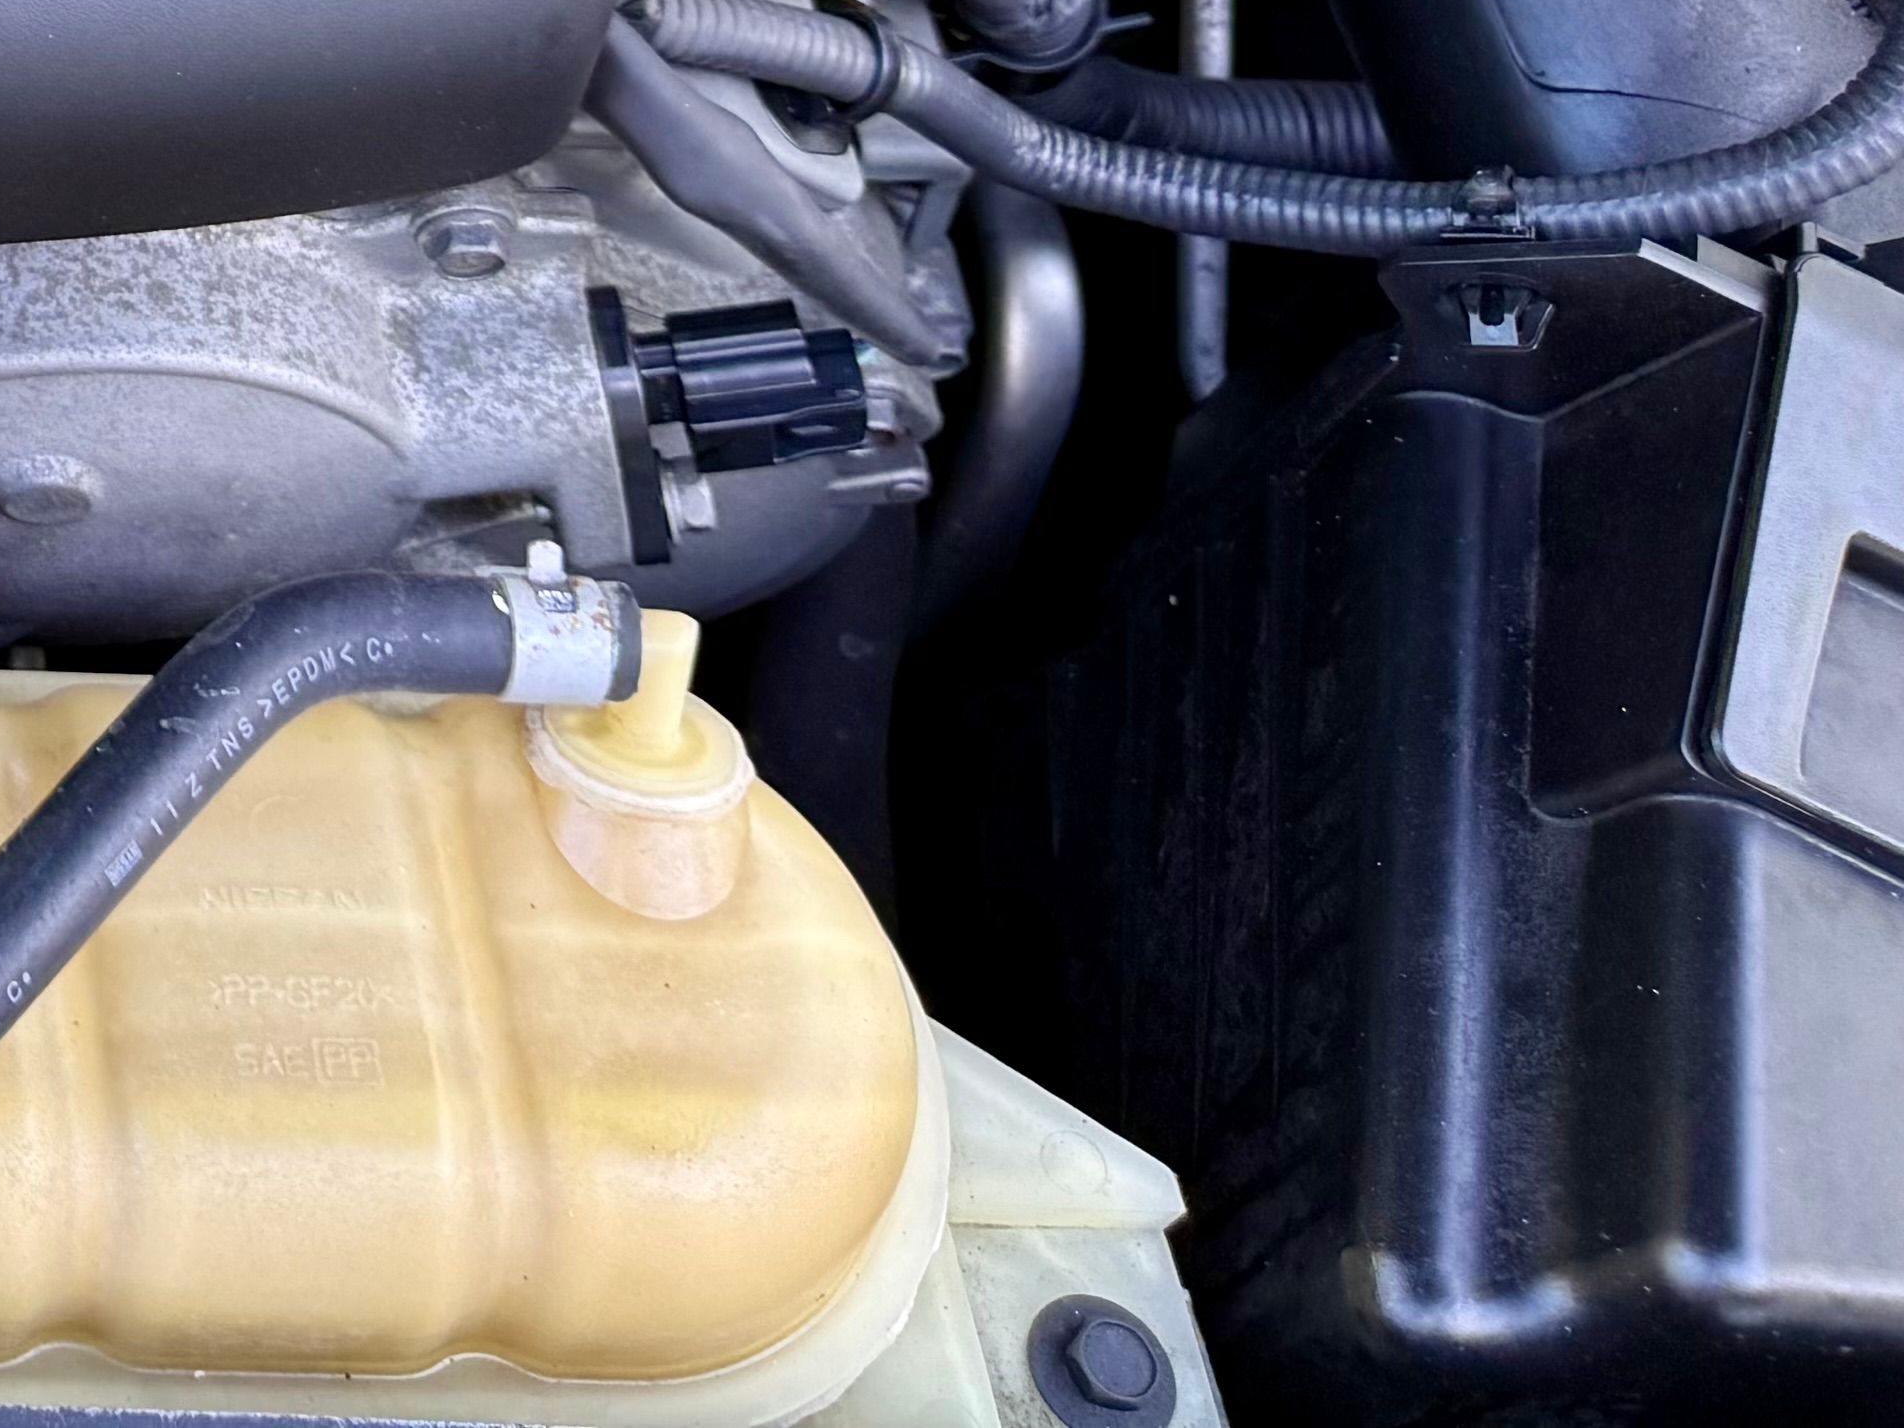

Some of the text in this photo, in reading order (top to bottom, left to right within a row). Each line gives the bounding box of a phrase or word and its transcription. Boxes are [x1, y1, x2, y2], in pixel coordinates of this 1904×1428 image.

[205, 716, 256, 772] TNS
[234, 1042, 310, 1077] SAE
[323, 1045, 370, 1077] PP
